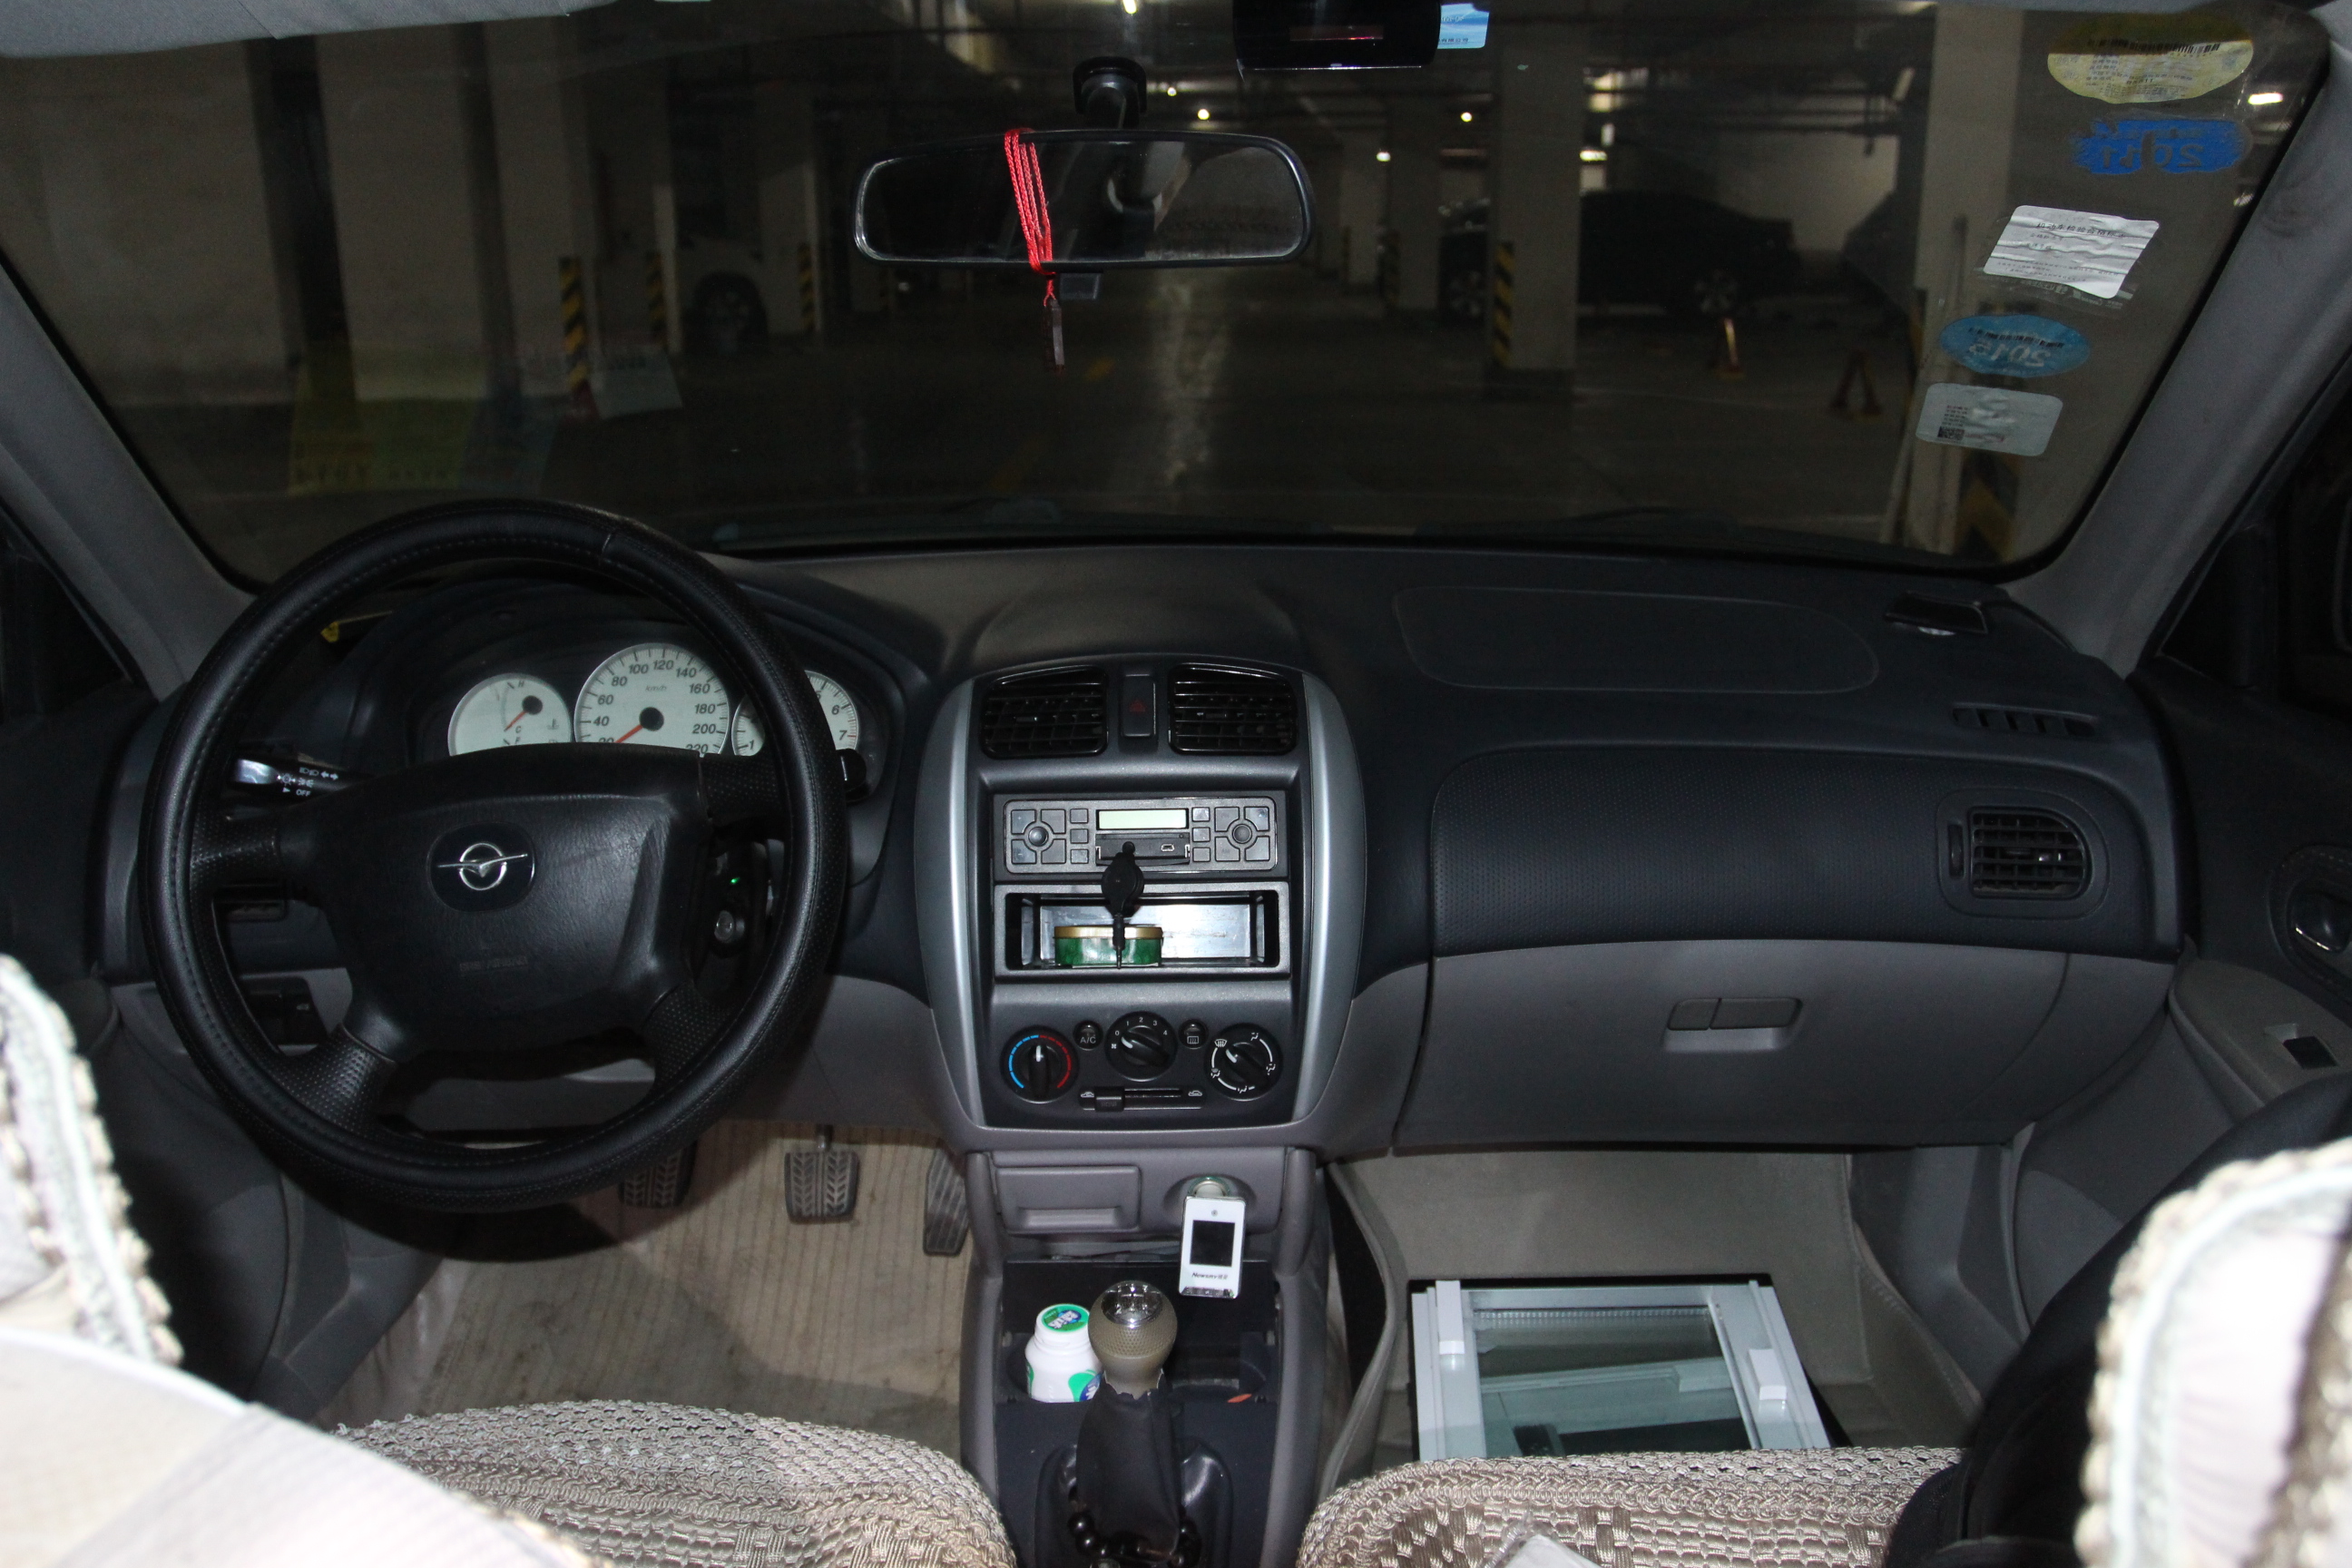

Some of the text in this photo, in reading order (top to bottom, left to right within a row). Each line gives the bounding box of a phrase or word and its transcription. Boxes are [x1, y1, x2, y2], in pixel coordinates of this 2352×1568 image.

[629, 664, 649, 674] 100
[653, 660, 674, 670] 120
[676, 668, 697, 678] 140
[611, 677, 628, 686] 80
[689, 683, 710, 694] 160
[597, 695, 613, 705] 60
[694, 704, 716, 713] 180
[831, 704, 840, 715] 6
[593, 716, 610, 726] 40
[692, 723, 717, 734] 200
[839, 730, 848, 740] 7
[296, 789, 311, 797] OFF
